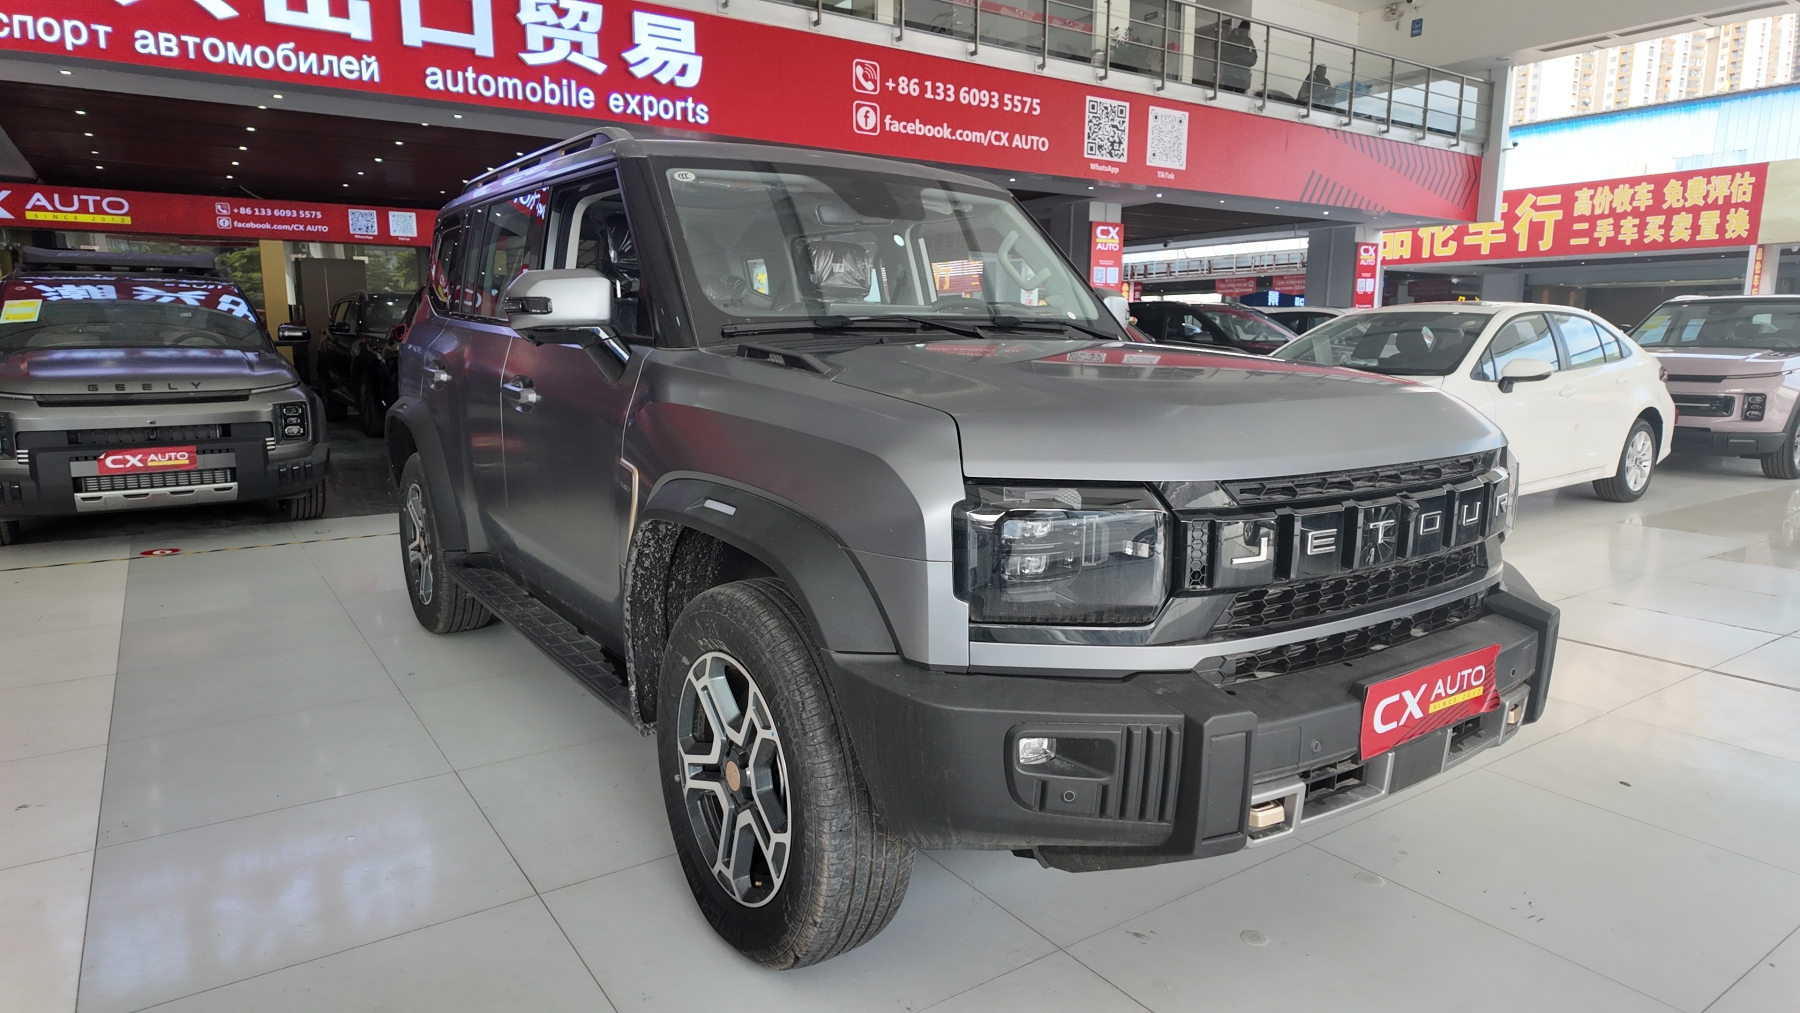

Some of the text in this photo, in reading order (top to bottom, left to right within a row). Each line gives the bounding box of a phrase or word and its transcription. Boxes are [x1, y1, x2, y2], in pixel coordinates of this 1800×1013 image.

[134, 29, 381, 83] автомобилей
[425, 65, 710, 125] automobile exports
[885, 76, 1041, 116] +86 133 6093 5575
[884, 114, 1049, 152] facebook.com/CX AUTO
[1089, 162, 1120, 174] WhatsApp
[1157, 170, 1175, 180] TikTok
[25, 191, 130, 215] AUTO
[1573, 171, 1756, 217] 高价收车 免费评估
[34, 213, 79, 221] SINCE
[233, 206, 323, 219] +86 133 6093 5575
[233, 221, 329, 233] facebook.com/CX AUTO
[1095, 225, 1120, 240] CX
[1569, 206, 1751, 248] 二手车买卖置换
[1095, 242, 1120, 252] AUTO
[1360, 245, 1377, 256] CX
[87, 381, 202, 392] GEELY
[104, 454, 145, 469] CX
[147, 451, 189, 463] AUTO
[1231, 493, 1508, 566] JETOUR
[1373, 665, 1486, 734] CX AUTO
[1433, 688, 1481, 711] SINCE 2012
